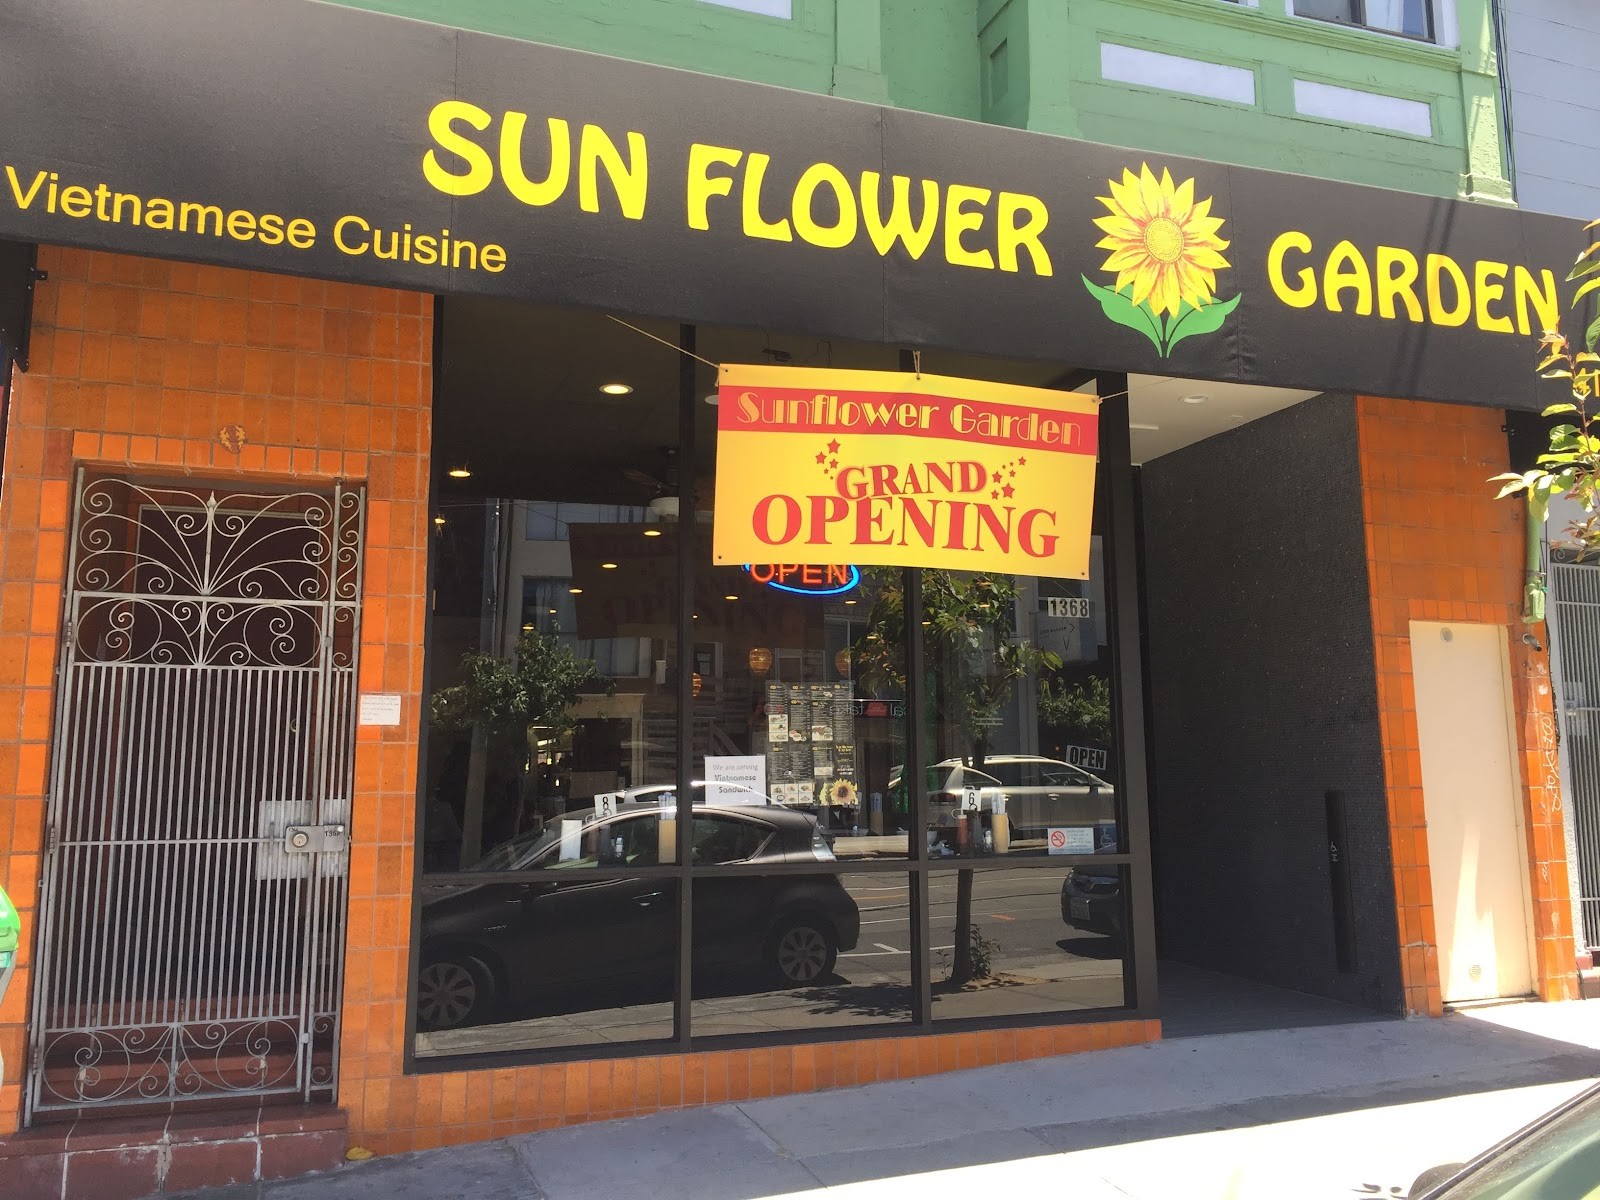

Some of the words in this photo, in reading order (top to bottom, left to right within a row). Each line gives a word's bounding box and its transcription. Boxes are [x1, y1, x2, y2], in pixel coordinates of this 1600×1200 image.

[5, 165, 316, 250] Vietnamese
[333, 215, 507, 274] Cuisine
[422, 100, 649, 220] SUN
[687, 142, 1054, 277] FLOWER
[1267, 231, 1559, 336] GARDEN
[736, 392, 940, 430] Sunflower
[949, 403, 1082, 447] Garden
[836, 461, 987, 500] GRAND
[752, 494, 1060, 558] OPENING
[750, 564, 848, 584] OPEN
[1050, 598, 1088, 617] 1368
[1069, 747, 1106, 769] OPEN
[714, 774, 757, 782] Vietnamese
[602, 796, 609, 810] 8
[968, 792, 975, 805] 6
